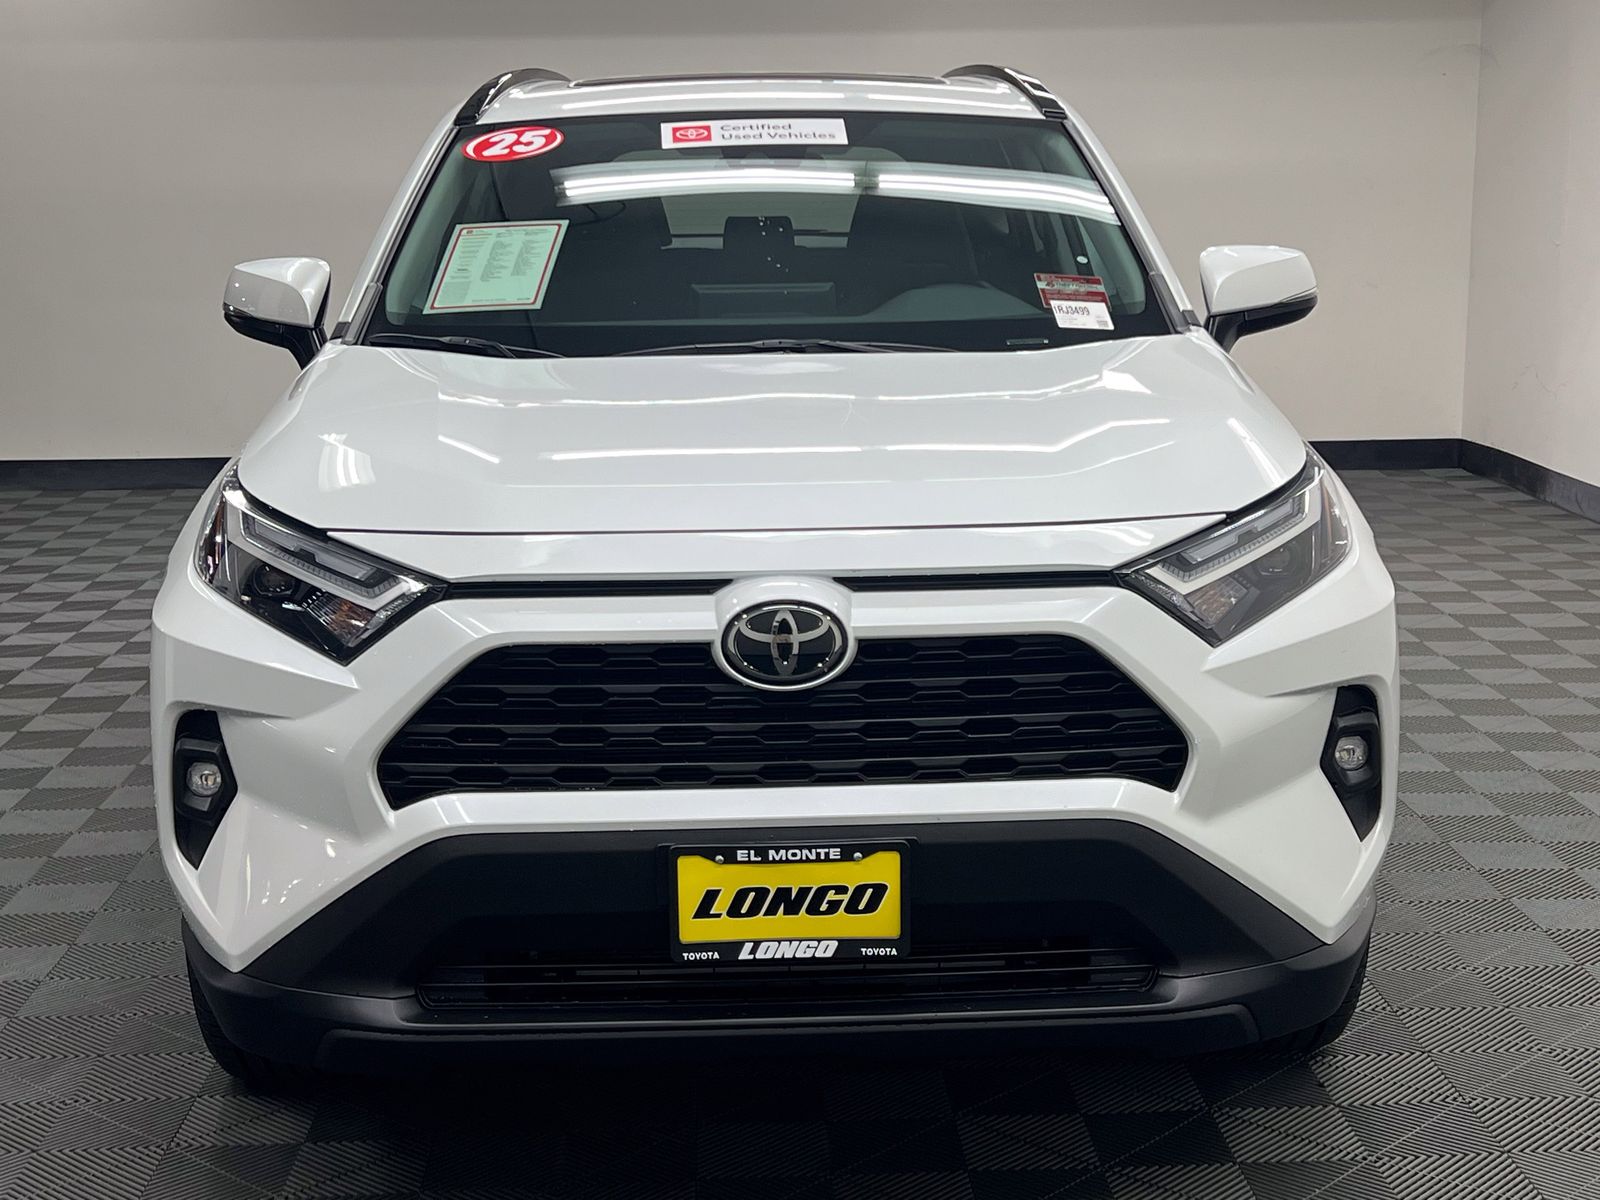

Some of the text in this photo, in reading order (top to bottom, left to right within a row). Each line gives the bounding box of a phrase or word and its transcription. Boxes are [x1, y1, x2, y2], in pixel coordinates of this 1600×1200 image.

[720, 123, 792, 132] Certified
[721, 131, 837, 141] Used Vehicles
[481, 129, 552, 157] 25
[736, 848, 842, 862] EL MONTE
[690, 882, 889, 921] LONGO
[682, 951, 720, 961] TOYOTA
[738, 940, 839, 961] LONGO
[860, 947, 898, 957] TOYOTA
